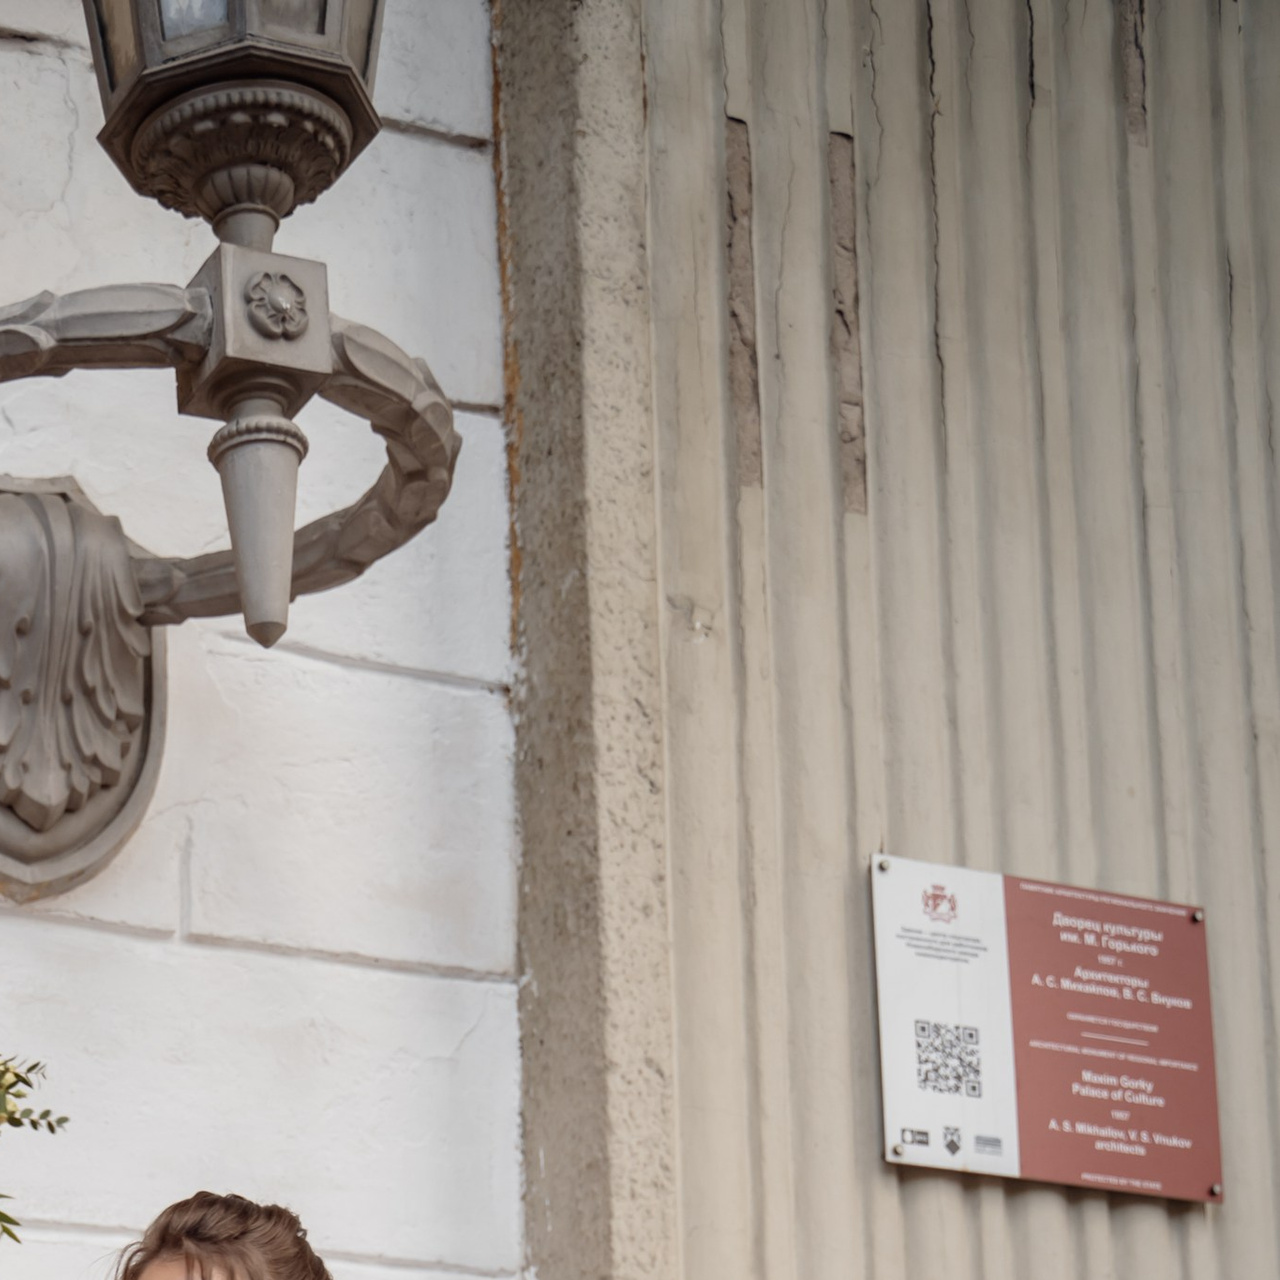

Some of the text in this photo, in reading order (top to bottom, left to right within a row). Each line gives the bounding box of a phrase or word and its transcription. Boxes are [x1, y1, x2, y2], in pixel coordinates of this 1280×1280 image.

[1052, 911, 1164, 942] Дворец культуры
[1060, 930, 1160, 957] им. М. Горького
[1074, 965, 1149, 989] Архитекторы
[1031, 973, 1193, 1009] А. С. Михайлов, В. С. Внуков
[1072, 1082, 1165, 1107] Palace of Culture
[1081, 1069, 1154, 1094] Maxim Gorky
[1048, 1118, 1193, 1149] A. S. Mikhailov, V. S. Vnukov
[1094, 1140, 1147, 1156] architects
